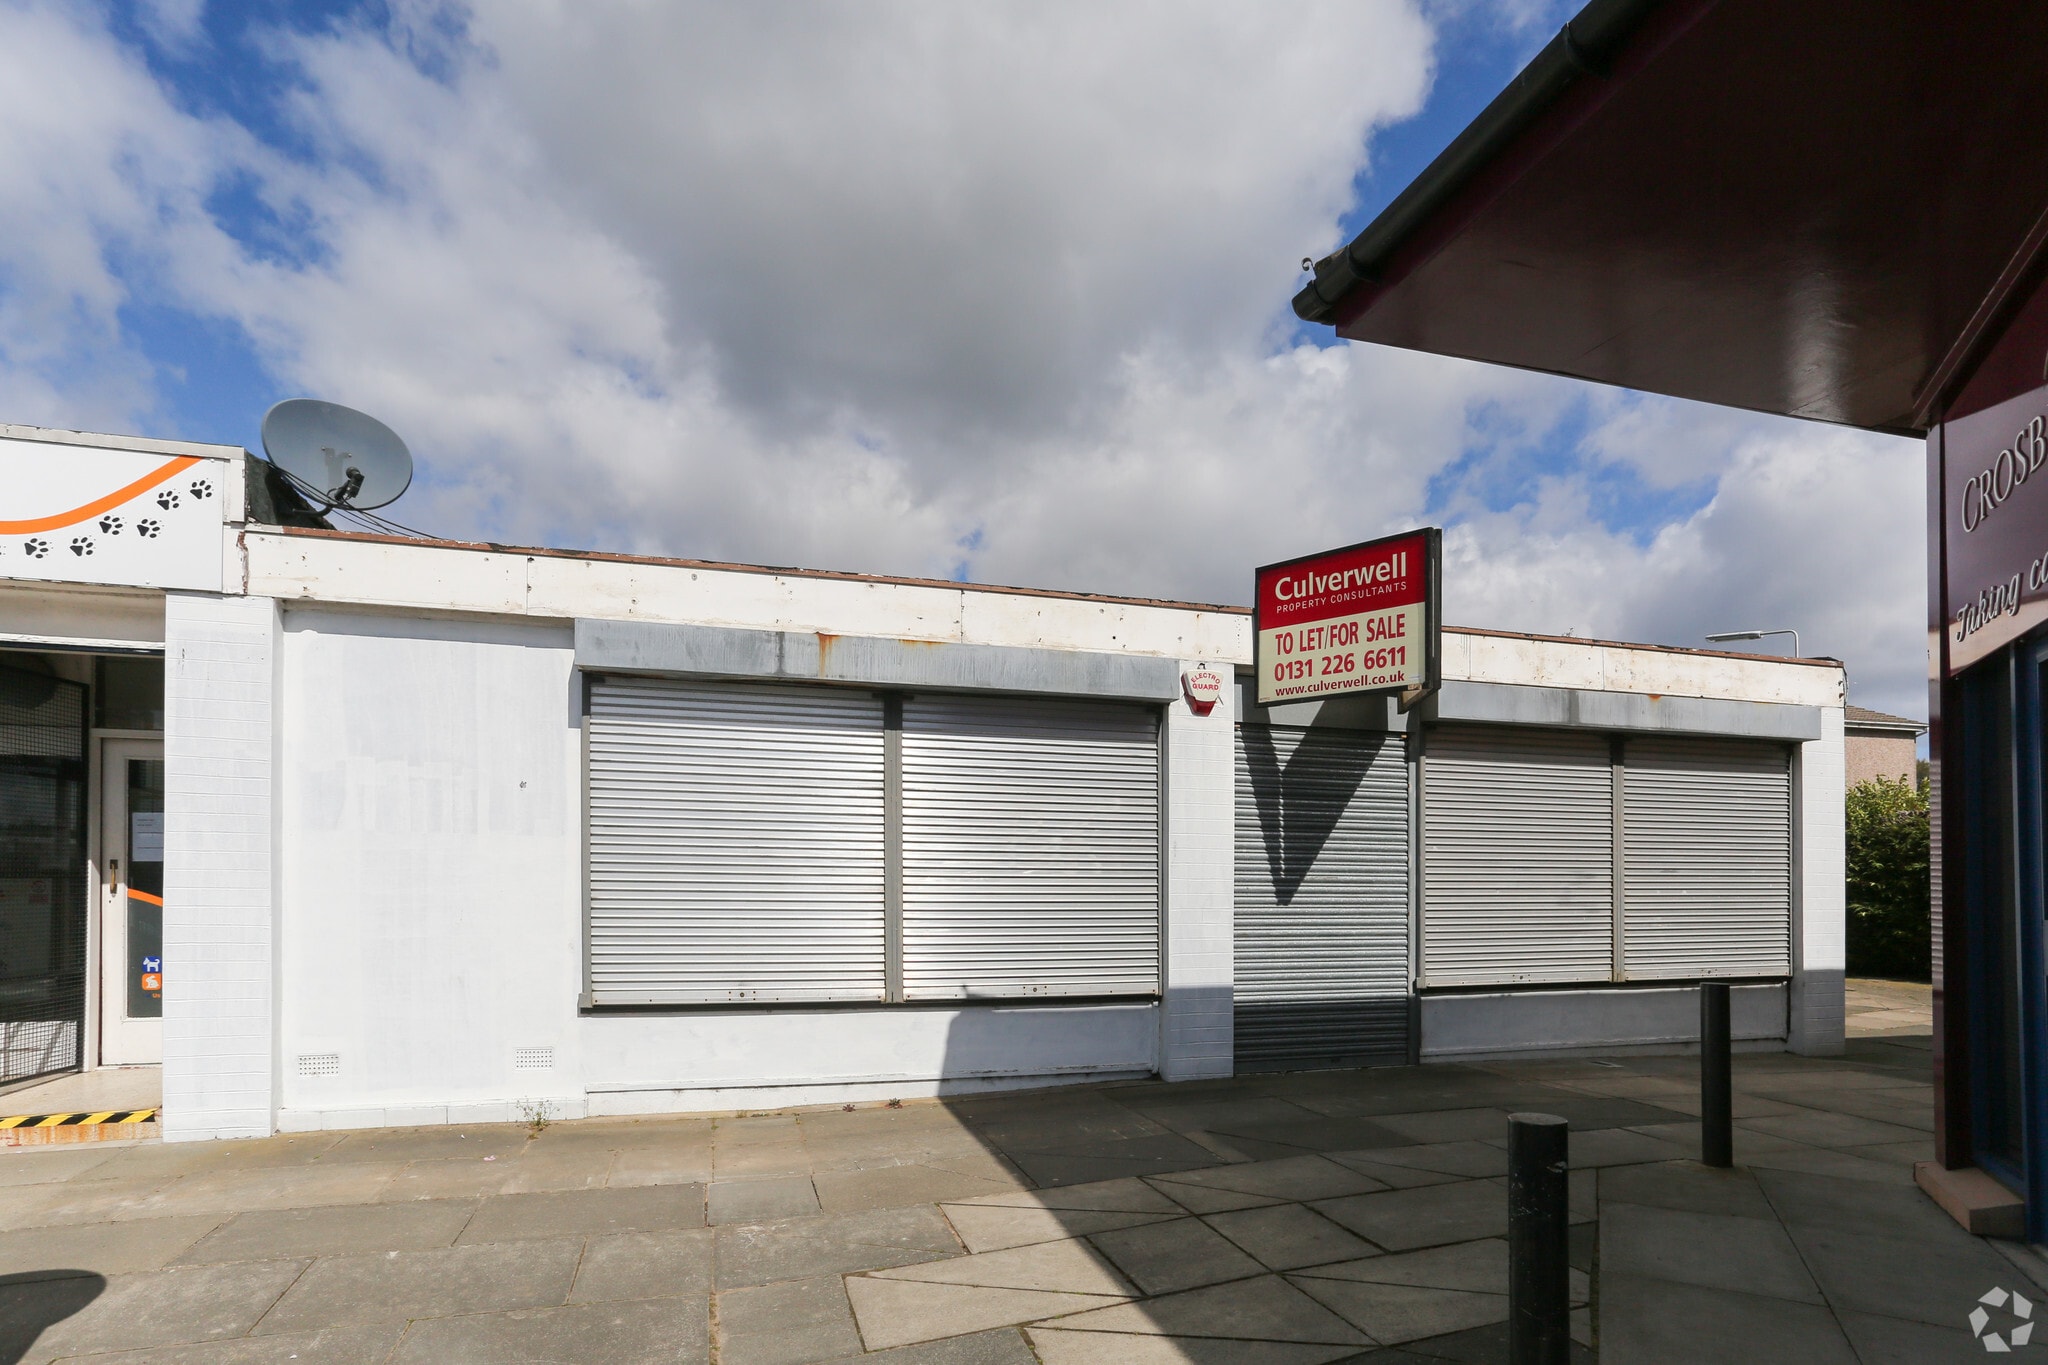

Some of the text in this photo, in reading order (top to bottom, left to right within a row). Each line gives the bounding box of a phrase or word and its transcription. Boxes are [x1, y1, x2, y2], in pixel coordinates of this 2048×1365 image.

[1961, 415, 2048, 533] CROSB
[1275, 552, 1407, 601] Culverwell
[1276, 581, 1407, 614] PROPERTY CONSULTANTS
[1956, 573, 2021, 642] Taking
[1275, 613, 1406, 656] TO LET/FOR SALE
[1190, 672, 1221, 684] ELECTRO
[1274, 645, 1406, 682] 0131 226 6611
[1192, 683, 1219, 691] GUARD
[1275, 671, 1405, 697] www.culverwell.co.uk
